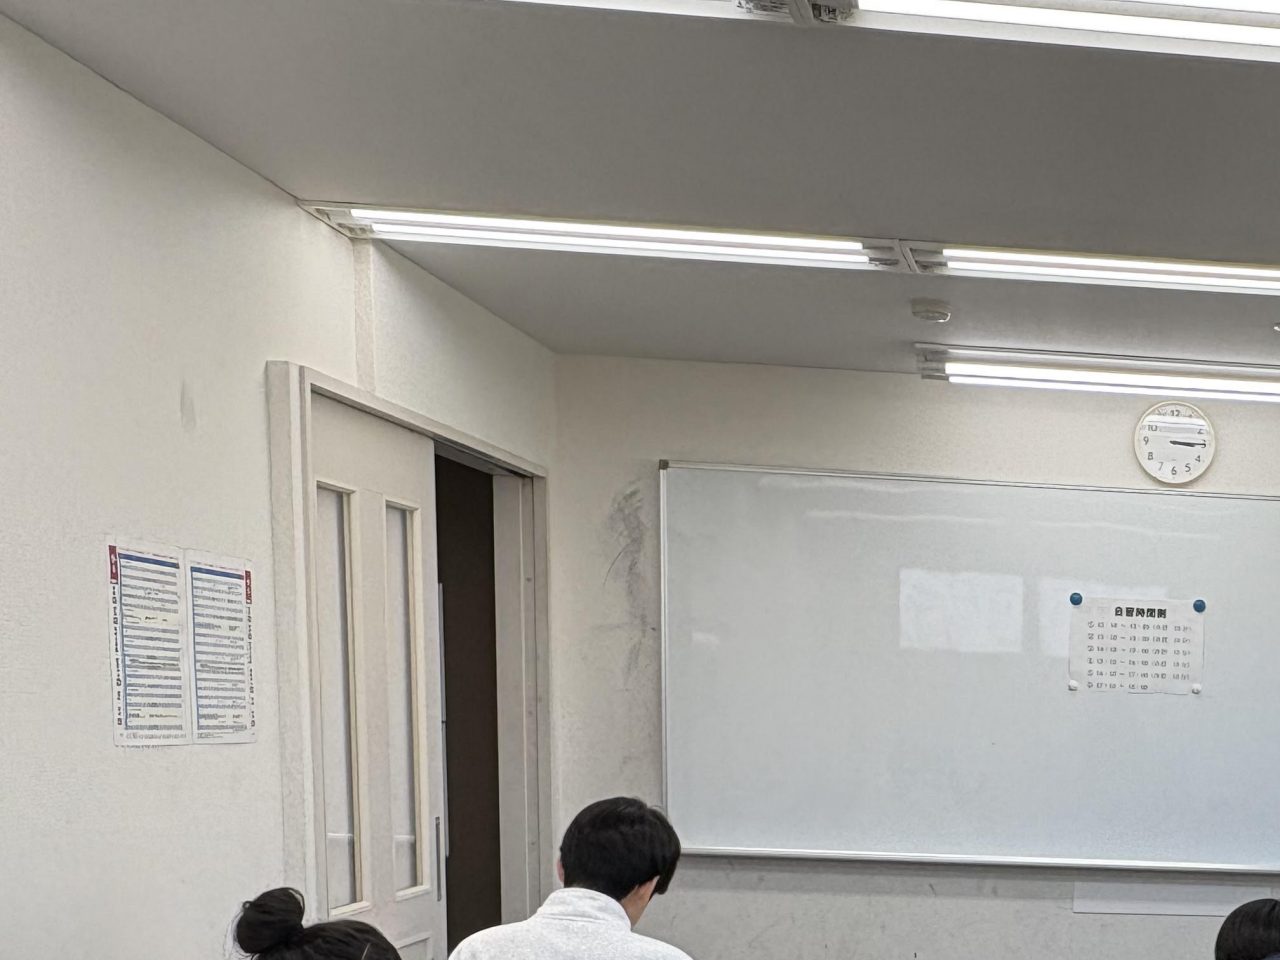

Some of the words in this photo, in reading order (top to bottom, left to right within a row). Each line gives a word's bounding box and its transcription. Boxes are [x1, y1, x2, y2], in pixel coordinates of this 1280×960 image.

[1170, 409, 1181, 417] 12
[1147, 424, 1158, 432] 10
[1143, 436, 1149, 445] 9
[1147, 451, 1154, 461] 8
[1194, 454, 1201, 463] 4
[1158, 461, 1164, 471] 7
[1184, 462, 1192, 473] 5
[1171, 466, 1178, 476] 6
